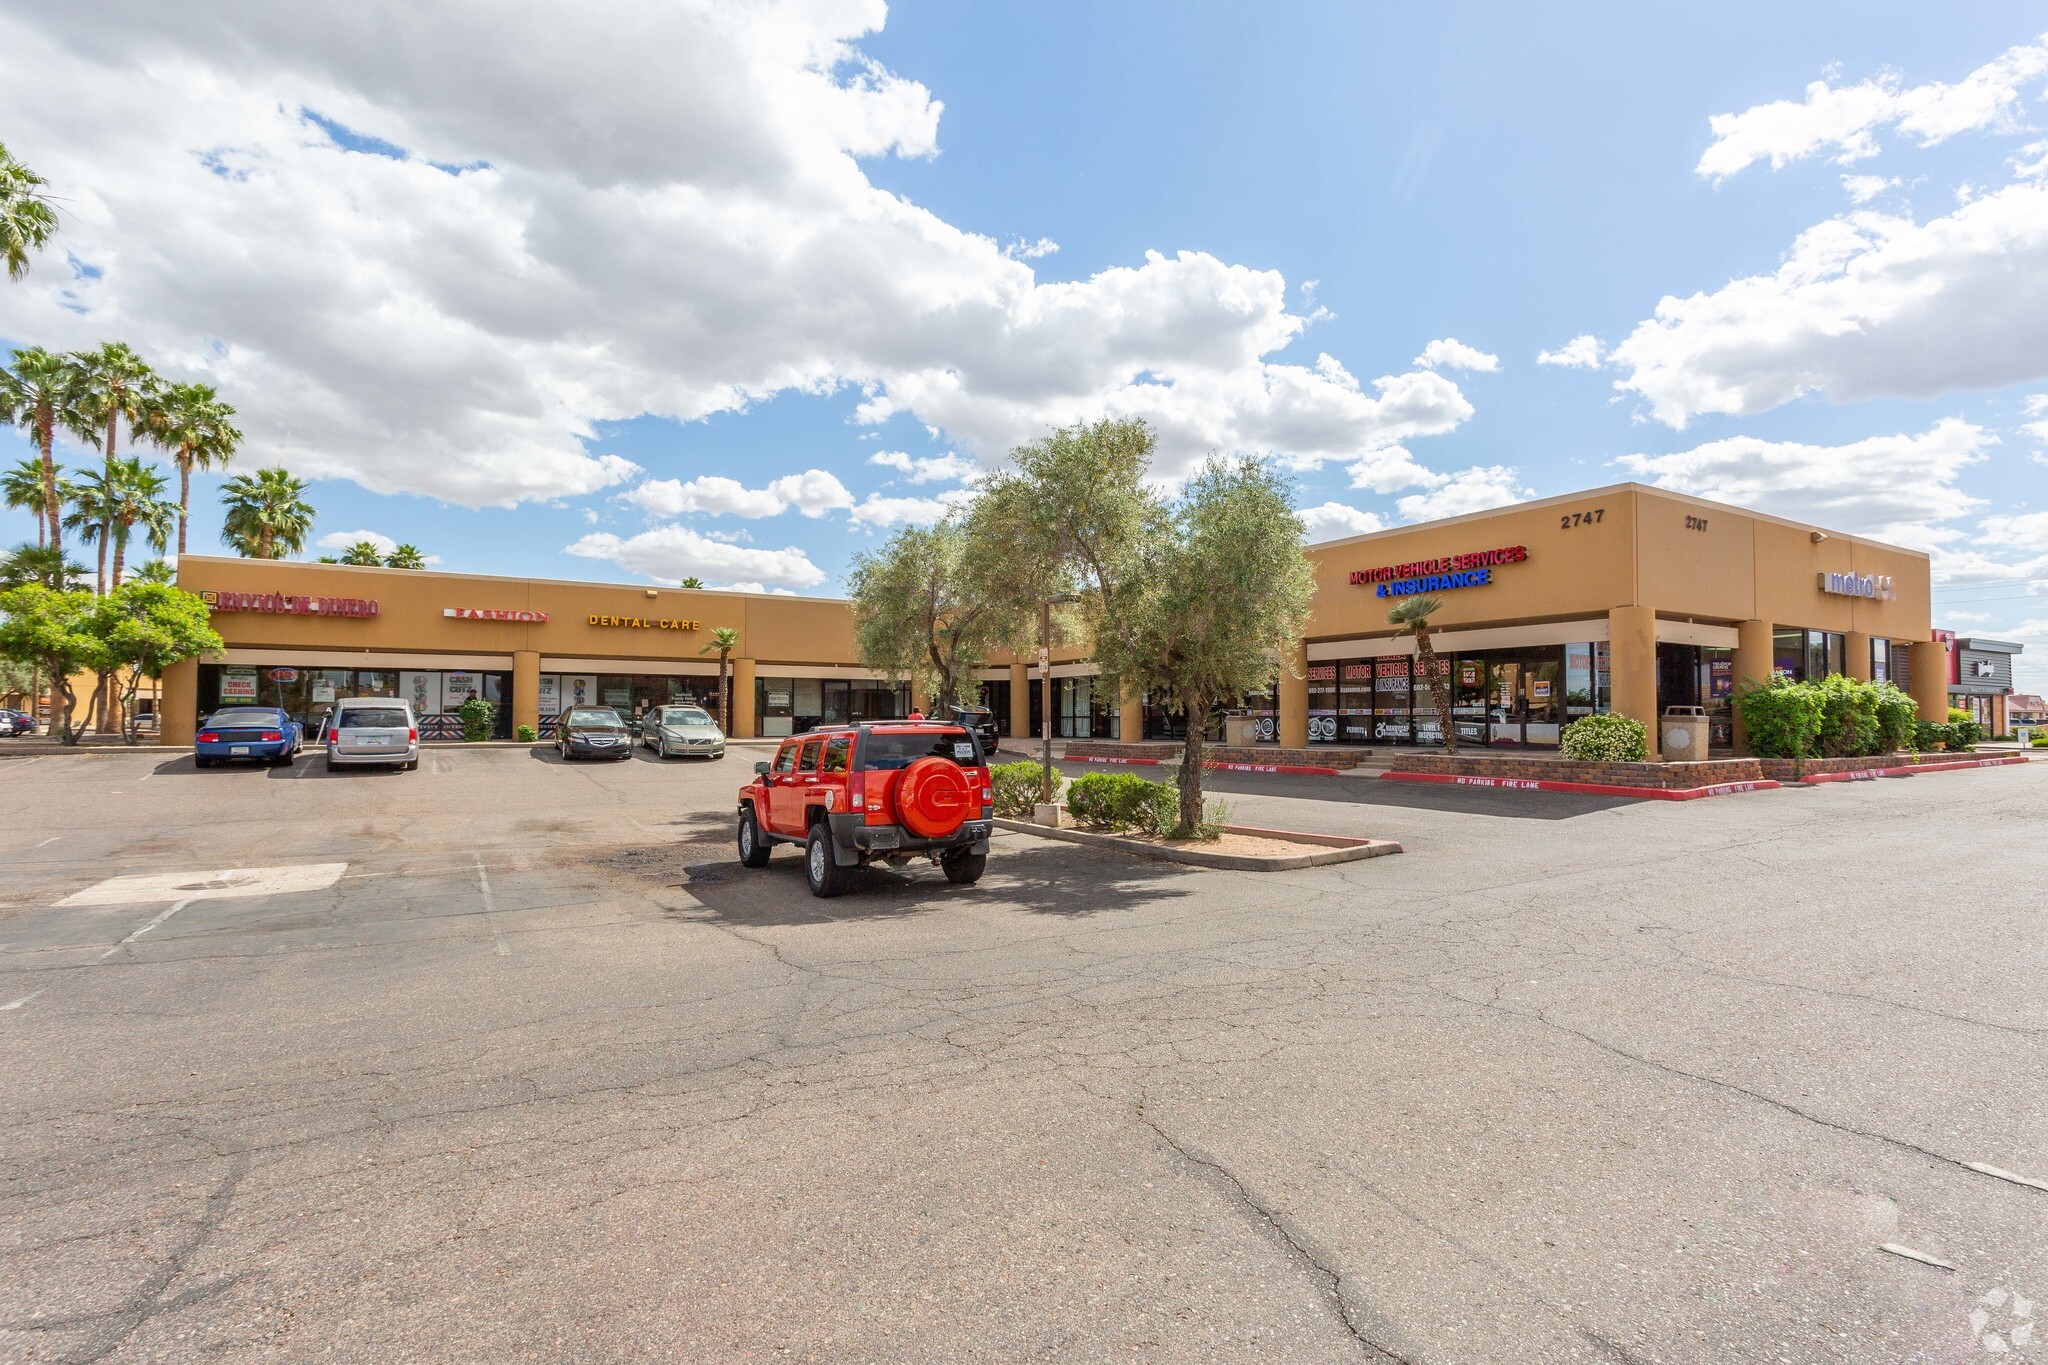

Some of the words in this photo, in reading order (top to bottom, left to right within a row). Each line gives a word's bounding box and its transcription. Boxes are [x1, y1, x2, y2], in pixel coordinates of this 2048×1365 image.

[1561, 509, 1605, 529] 2747
[1685, 515, 1708, 533] 2747
[1349, 566, 1393, 586] MOTOR
[1394, 556, 1451, 578] VEHICLE
[1452, 546, 1527, 571] SERVICES
[1376, 584, 1387, 599] &
[1390, 569, 1490, 597] INSURANCE
[219, 592, 286, 614] ENVIOS
[289, 595, 312, 616] DE
[316, 597, 380, 618] DINERO
[454, 608, 549, 623] FASHION
[589, 614, 651, 628] DENTAL
[659, 618, 700, 631] CARE
[1308, 666, 1336, 680] SERVICES
[1345, 665, 1371, 680] MOTOR
[1376, 662, 1408, 677] VEHICLE
[1414, 660, 1450, 676] SEES
[1380, 677, 1409, 692] INSURANCE
[1346, 726, 1365, 734] PERMITS
[1461, 727, 1477, 736] TITLES
[1468, 778, 1495, 786] PARKING
[1502, 780, 1518, 788] FIRE
[1521, 781, 1539, 789] LANE
[1715, 786, 1731, 795] PARKING
[1744, 783, 1755, 791] LANE
